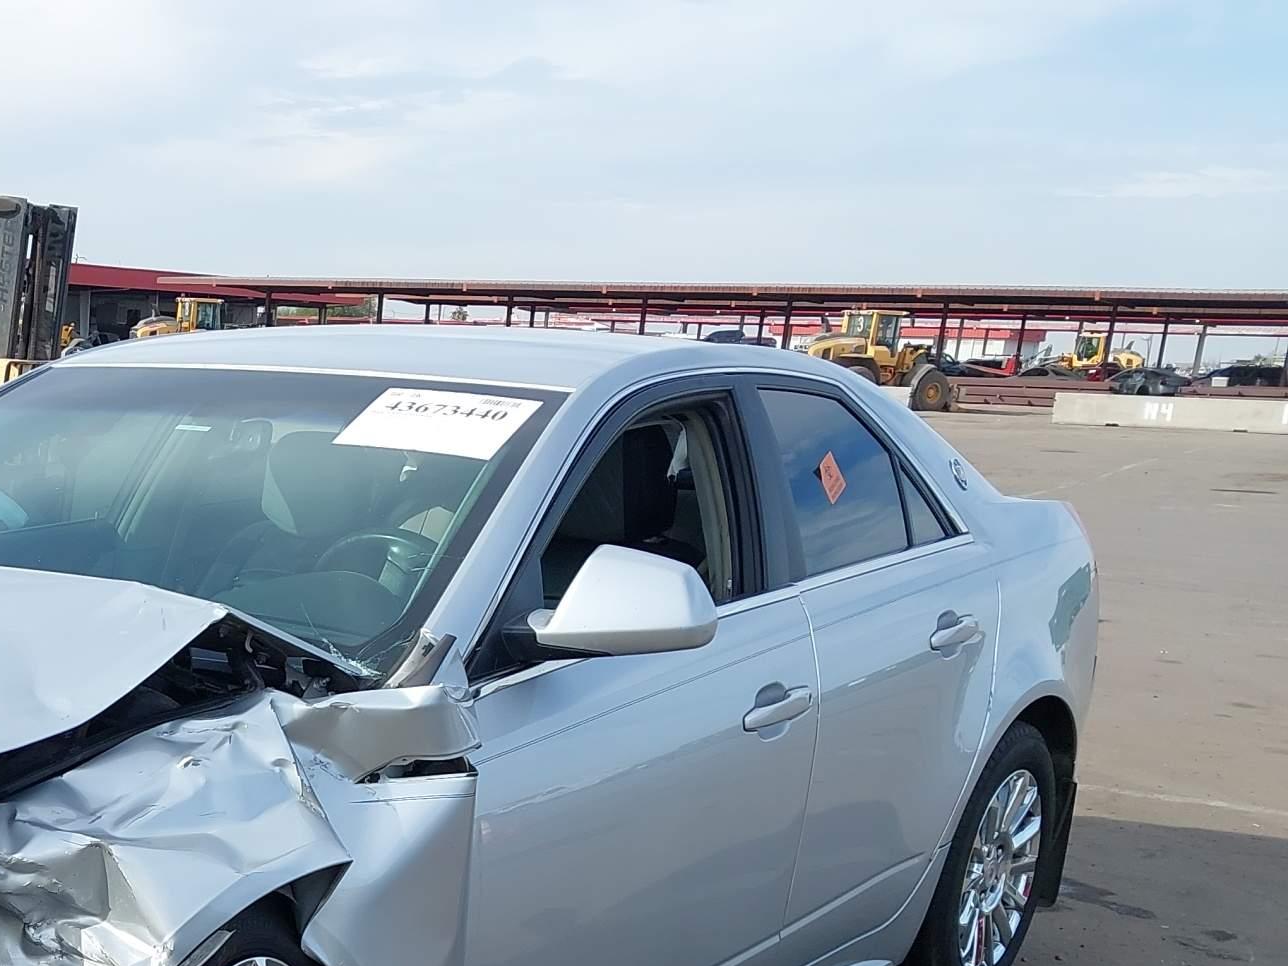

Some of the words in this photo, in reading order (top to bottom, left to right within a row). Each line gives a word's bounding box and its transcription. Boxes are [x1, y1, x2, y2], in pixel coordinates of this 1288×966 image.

[857, 316, 865, 332] 3
[385, 400, 508, 422] 43673440
[1144, 401, 1175, 422] N4
